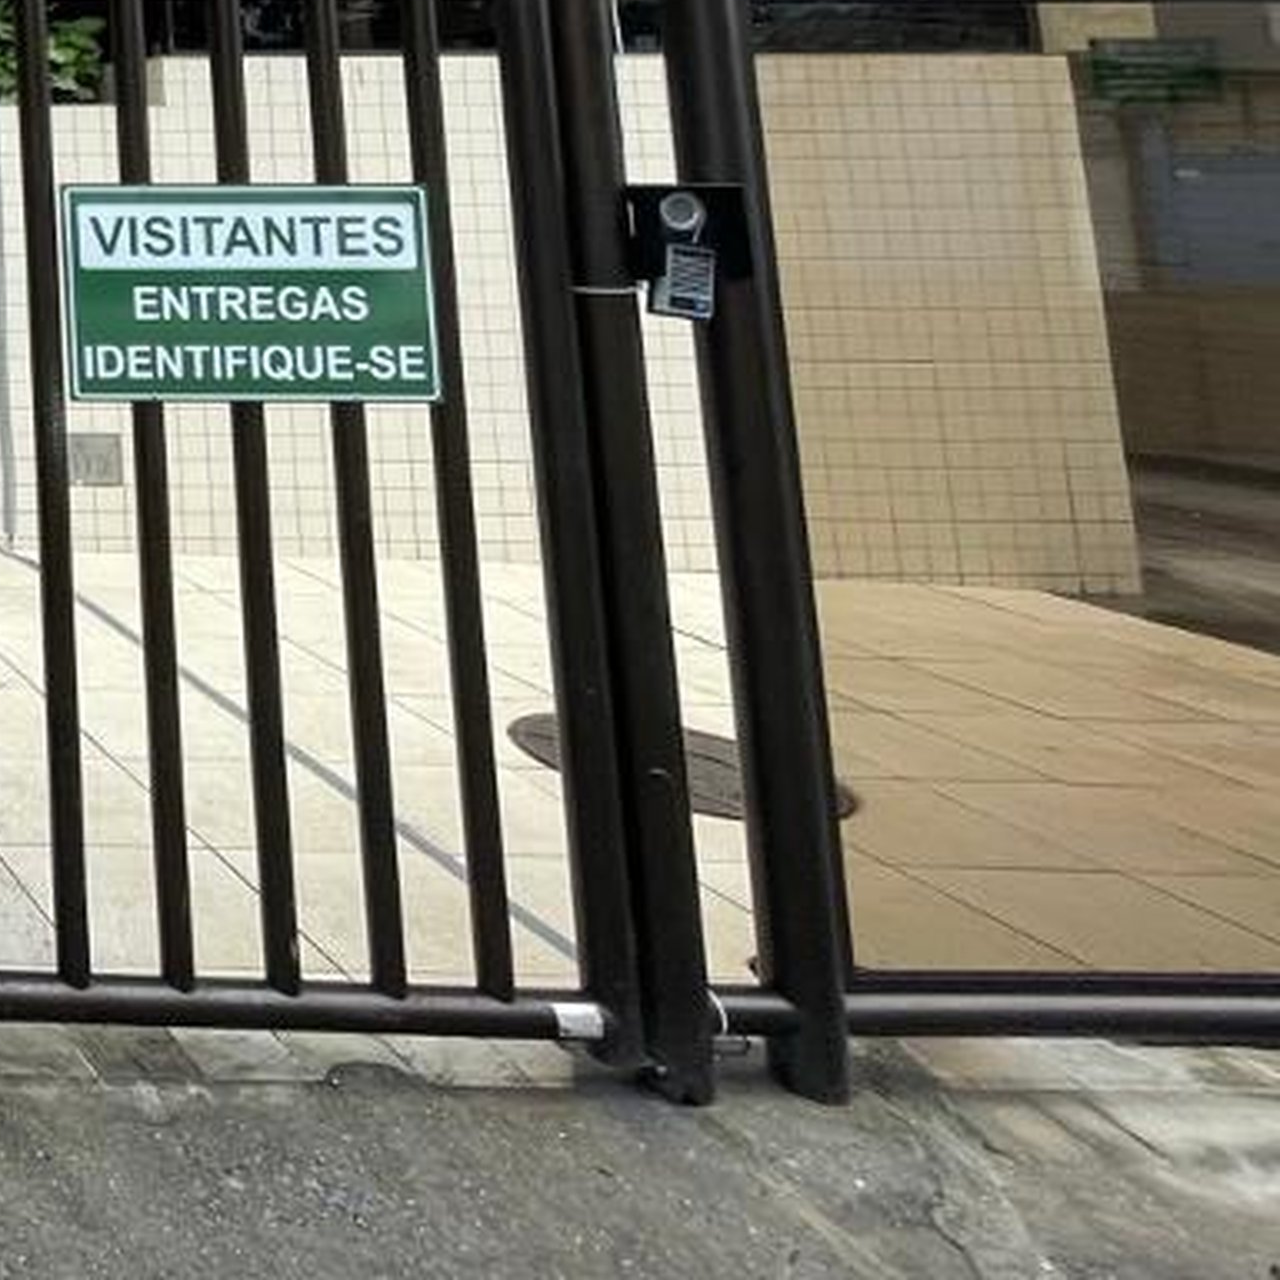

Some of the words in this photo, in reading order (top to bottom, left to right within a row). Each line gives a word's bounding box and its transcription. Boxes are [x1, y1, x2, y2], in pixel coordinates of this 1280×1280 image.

[90, 216, 405, 258] VISITANTES
[132, 285, 370, 322] ENTREGAS
[83, 344, 428, 381] IDENTIFIQUE-SE
